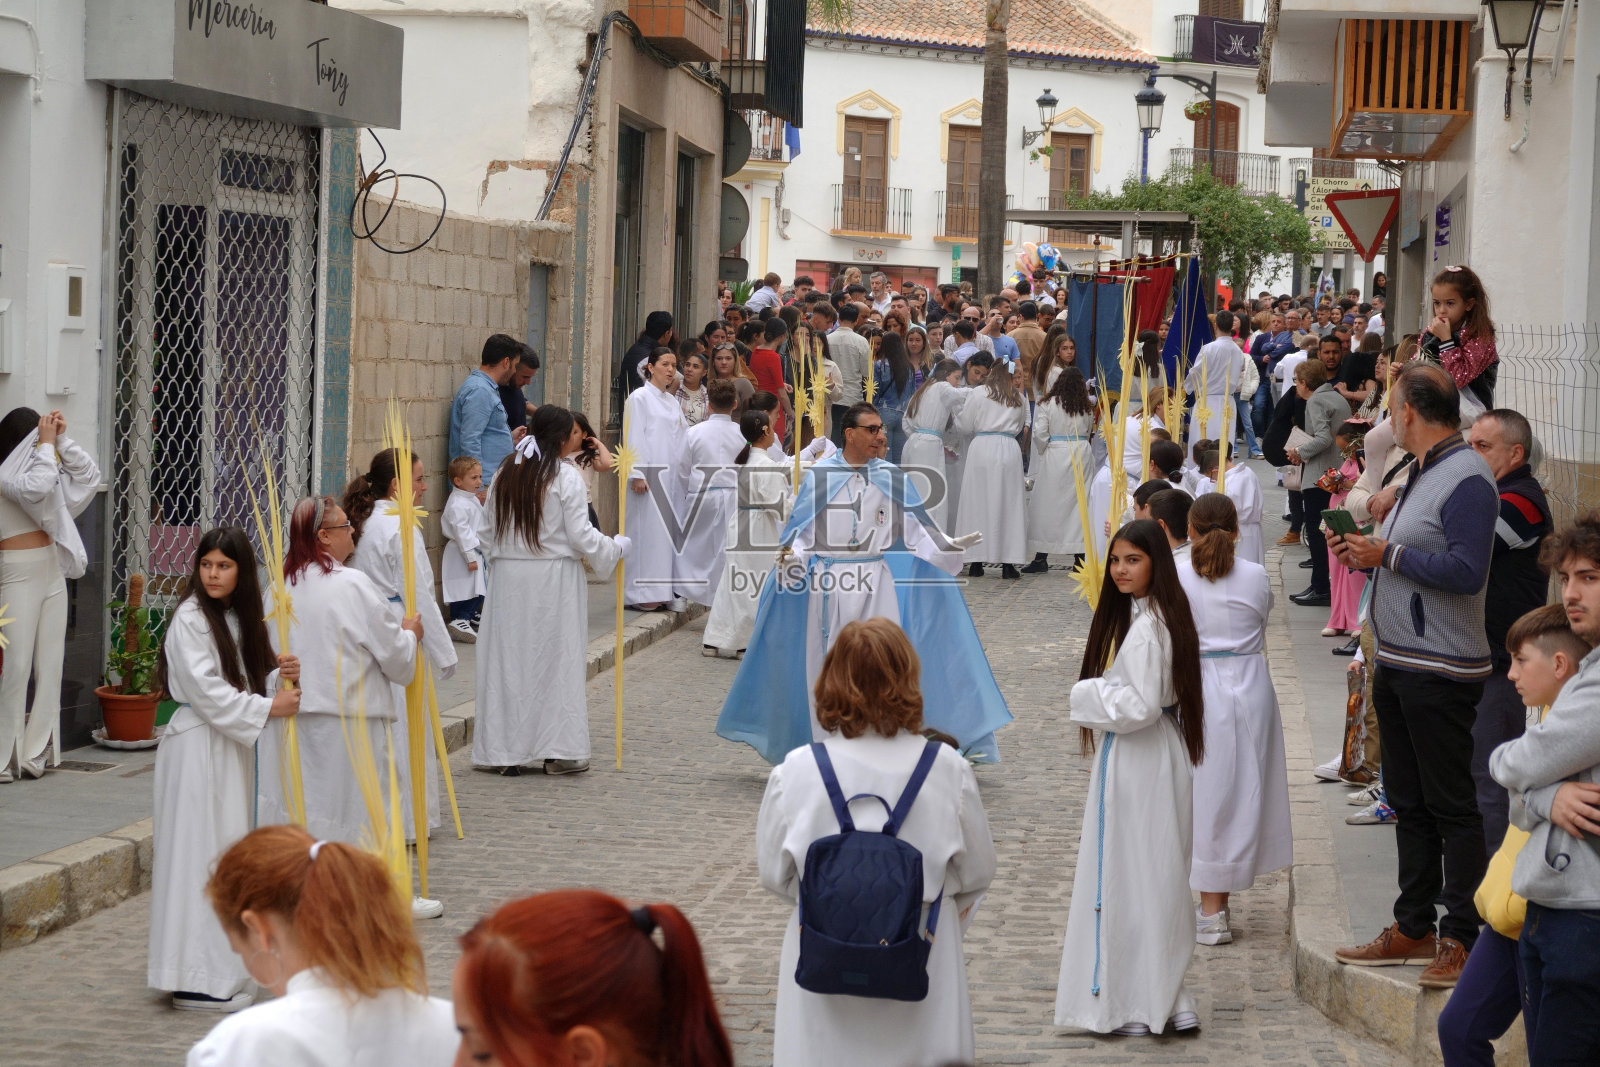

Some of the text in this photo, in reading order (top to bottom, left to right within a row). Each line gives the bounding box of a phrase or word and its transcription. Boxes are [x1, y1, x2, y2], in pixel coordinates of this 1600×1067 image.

[306, 38, 349, 107] Toñy
[1324, 217, 1330, 226] P
[1325, 240, 1354, 248] NTEQU
